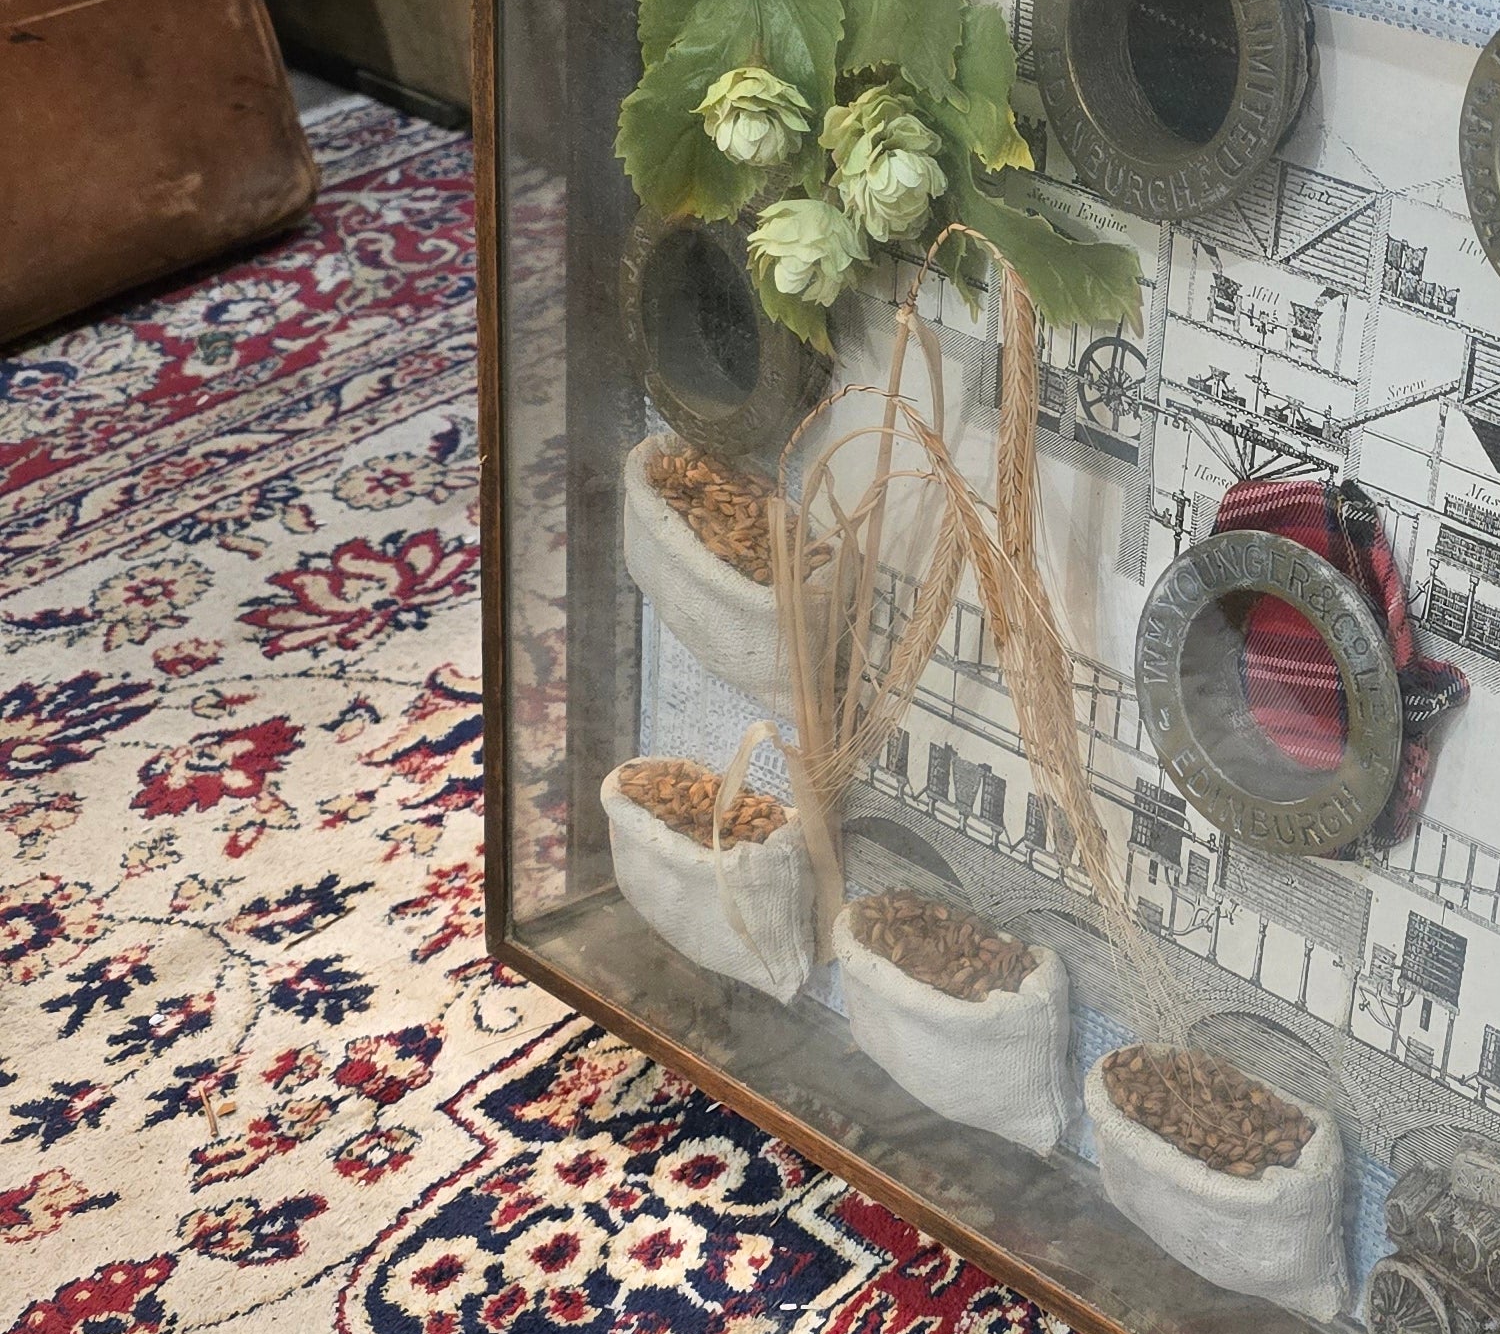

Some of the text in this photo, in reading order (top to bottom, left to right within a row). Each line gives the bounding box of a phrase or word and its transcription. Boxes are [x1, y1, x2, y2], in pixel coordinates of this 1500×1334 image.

[1039, 52, 1198, 214] EDINBURGH
[1026, 186, 1128, 232] Steam Engine
[1246, 284, 1282, 305] Mill
[1388, 379, 1426, 400] Screw
[1193, 464, 1233, 489] Horse
[1160, 543, 1311, 621] YOUNGER
[1309, 584, 1337, 621] &
[1170, 748, 1362, 848] EDINBURGH
